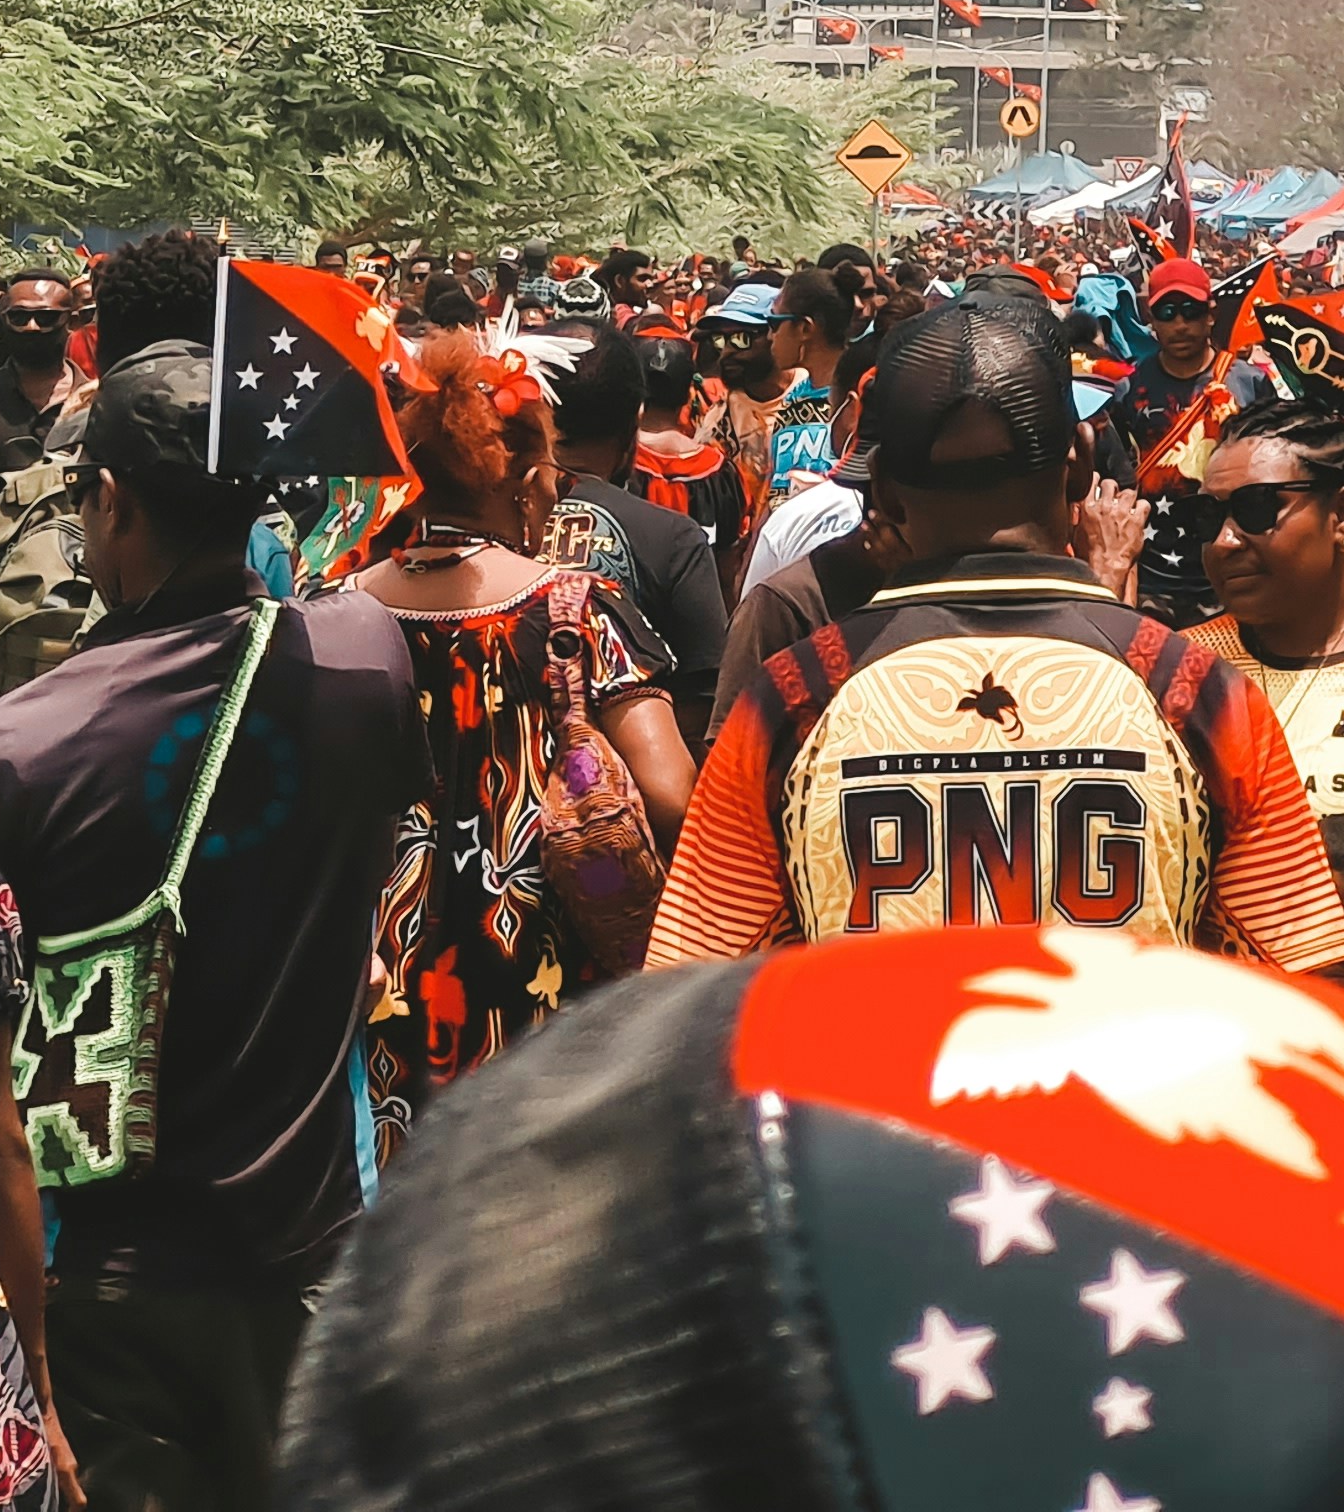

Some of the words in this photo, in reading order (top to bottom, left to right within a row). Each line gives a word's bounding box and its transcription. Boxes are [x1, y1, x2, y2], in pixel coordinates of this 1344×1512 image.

[592, 536, 614, 553] 75
[878, 755, 978, 772] BIGPLA
[1003, 752, 1105, 769] BLESIM
[840, 778, 1147, 932] PNG
